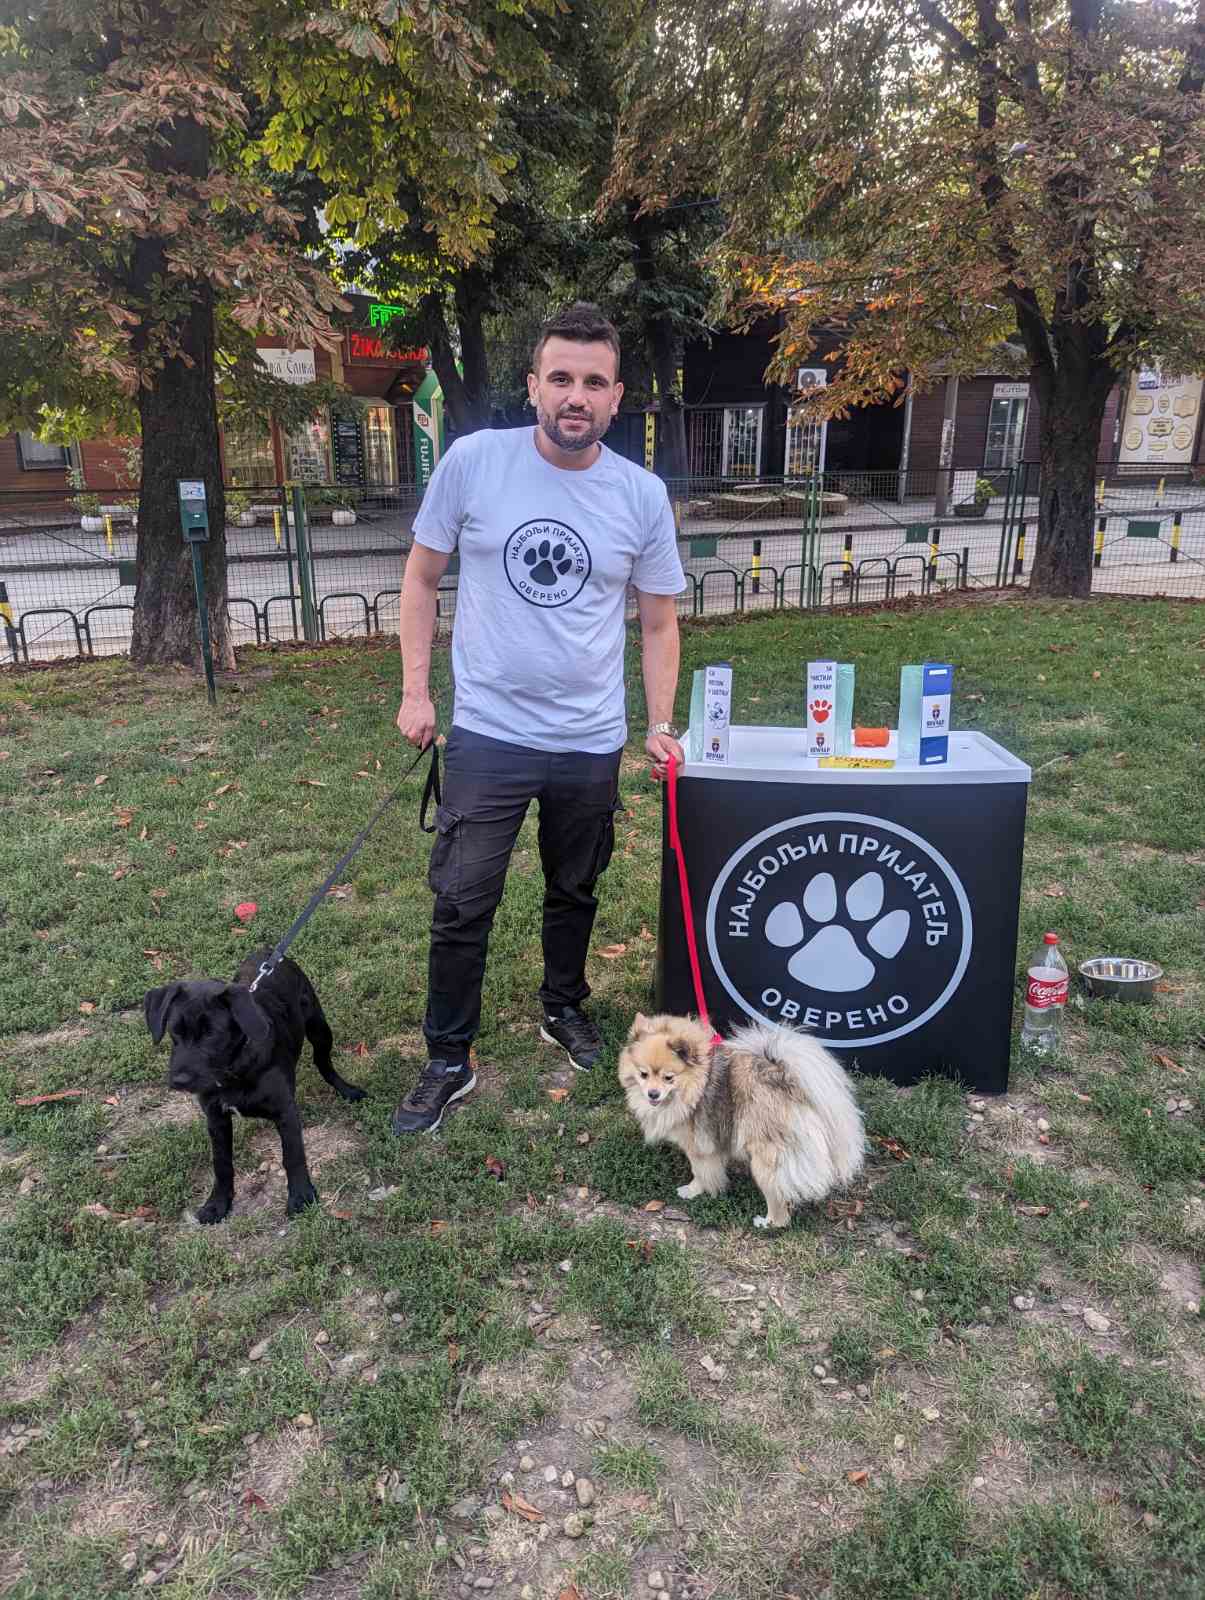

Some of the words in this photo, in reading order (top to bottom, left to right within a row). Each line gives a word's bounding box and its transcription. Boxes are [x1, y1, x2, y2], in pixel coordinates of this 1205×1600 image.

[419, 438, 430, 486] FUJIFIL
[511, 526, 550, 560] НАЈБОЉИ
[519, 580, 568, 600] ОВЕРЕНО
[729, 834, 828, 937] НАЈБОЉИ
[839, 834, 949, 946] ПРИЈАТЕЉ
[761, 988, 909, 1030] ОВЕРЕНО
